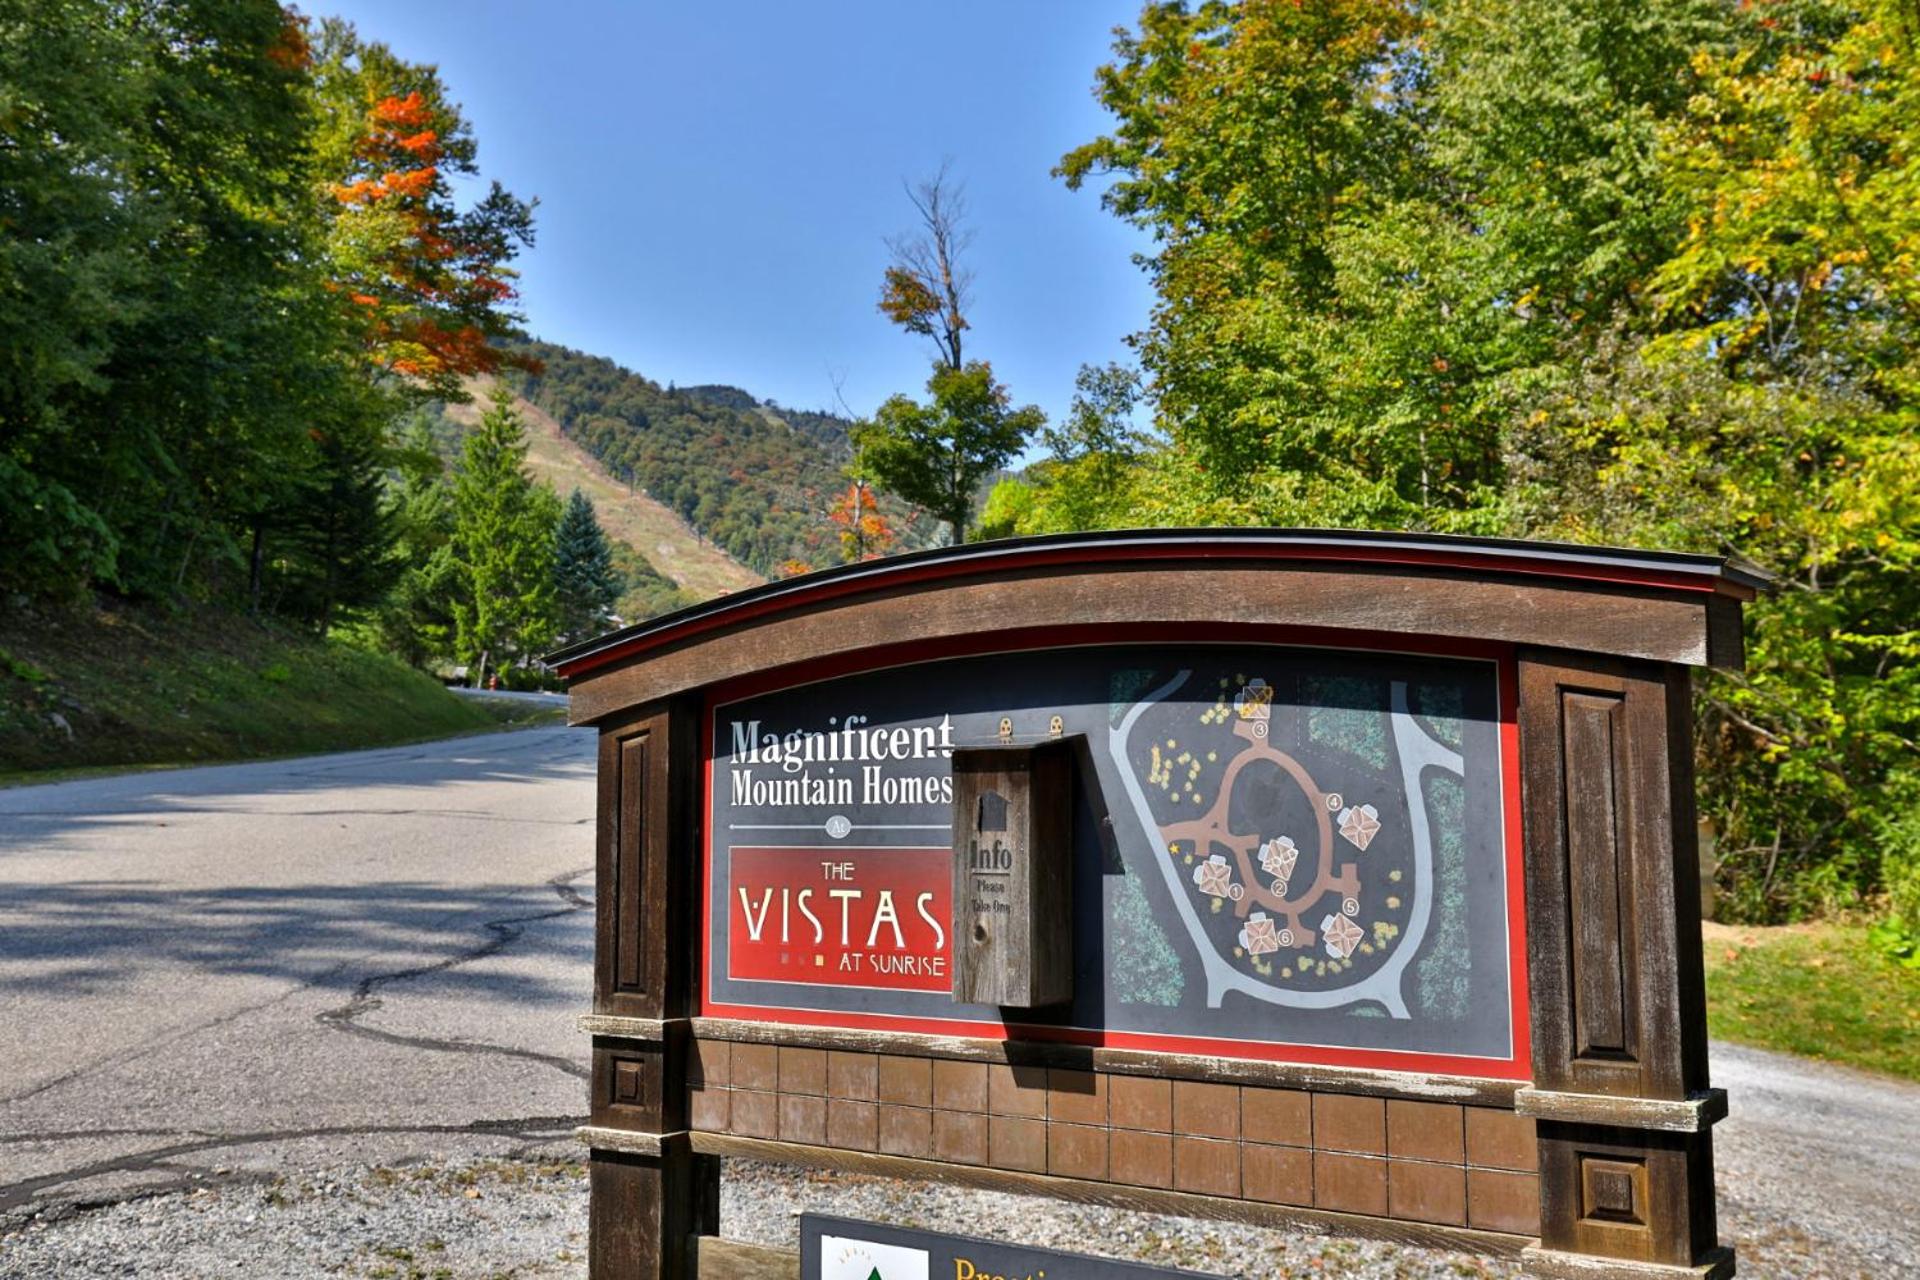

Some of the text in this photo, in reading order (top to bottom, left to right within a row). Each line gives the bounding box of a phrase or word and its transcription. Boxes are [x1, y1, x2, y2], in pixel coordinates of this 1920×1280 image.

[731, 713, 954, 772] Magnificent
[731, 766, 953, 806] Mountain Homes
[970, 839, 1012, 870] Info
[821, 862, 855, 880] THE
[976, 879, 1005, 893] Please
[739, 887, 945, 950] VISTAS
[972, 900, 991, 913] Take
[839, 953, 947, 977] AT SUNRISE
